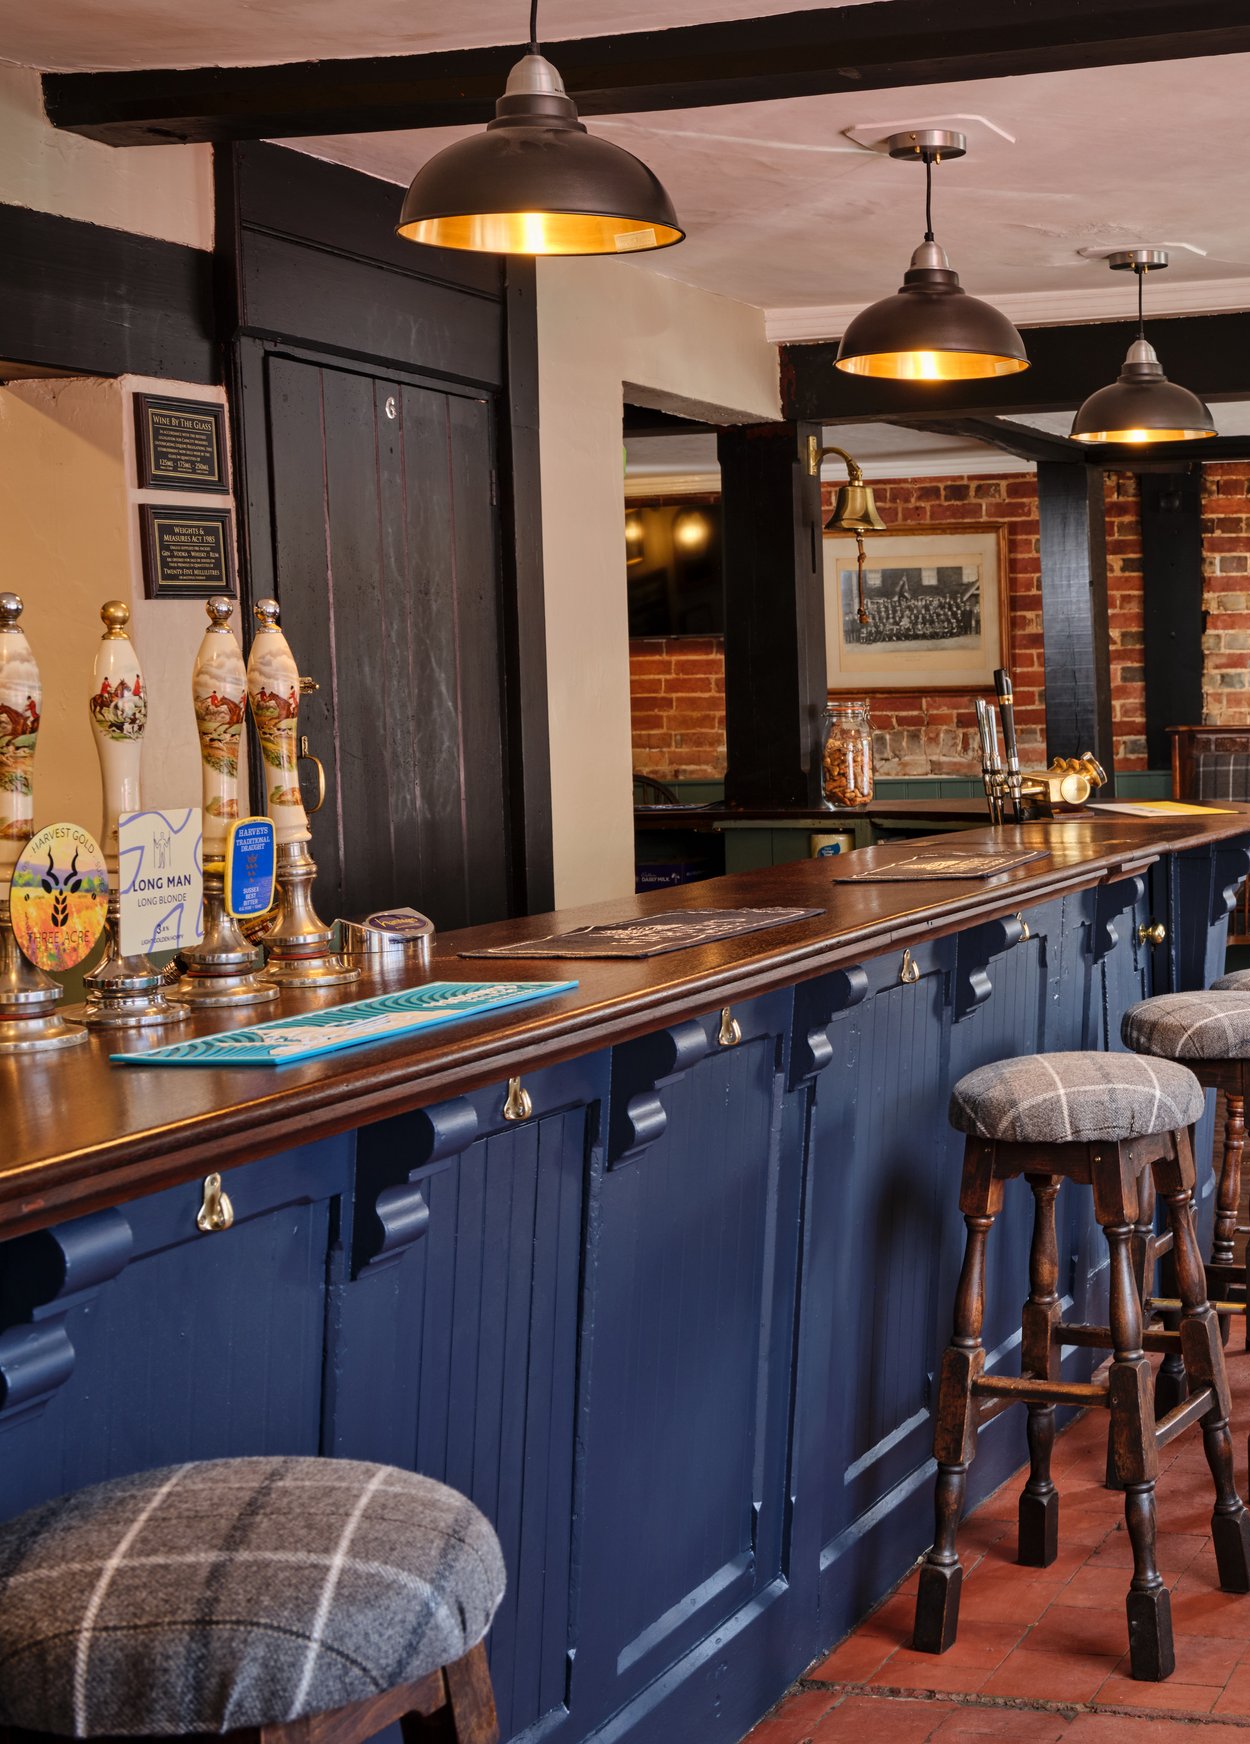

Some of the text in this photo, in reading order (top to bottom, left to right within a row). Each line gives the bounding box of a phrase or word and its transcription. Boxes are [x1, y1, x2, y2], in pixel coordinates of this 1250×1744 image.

[152, 414, 170, 425] WINE
[181, 419, 193, 428] THE
[193, 421, 212, 430] GLASS
[174, 526, 199, 535] WEIGHTS
[163, 534, 190, 542] MEASURES
[238, 827, 268, 837] HARVEYS
[31, 827, 95, 854] HARVEST GOLD
[236, 836, 270, 847] TRADITIONAL
[241, 843, 265, 852] DRAUGHT
[132, 874, 192, 892] LONG MAN
[137, 893, 187, 908] LONG BLONDE
[27, 930, 90, 945] THREE ACRE
